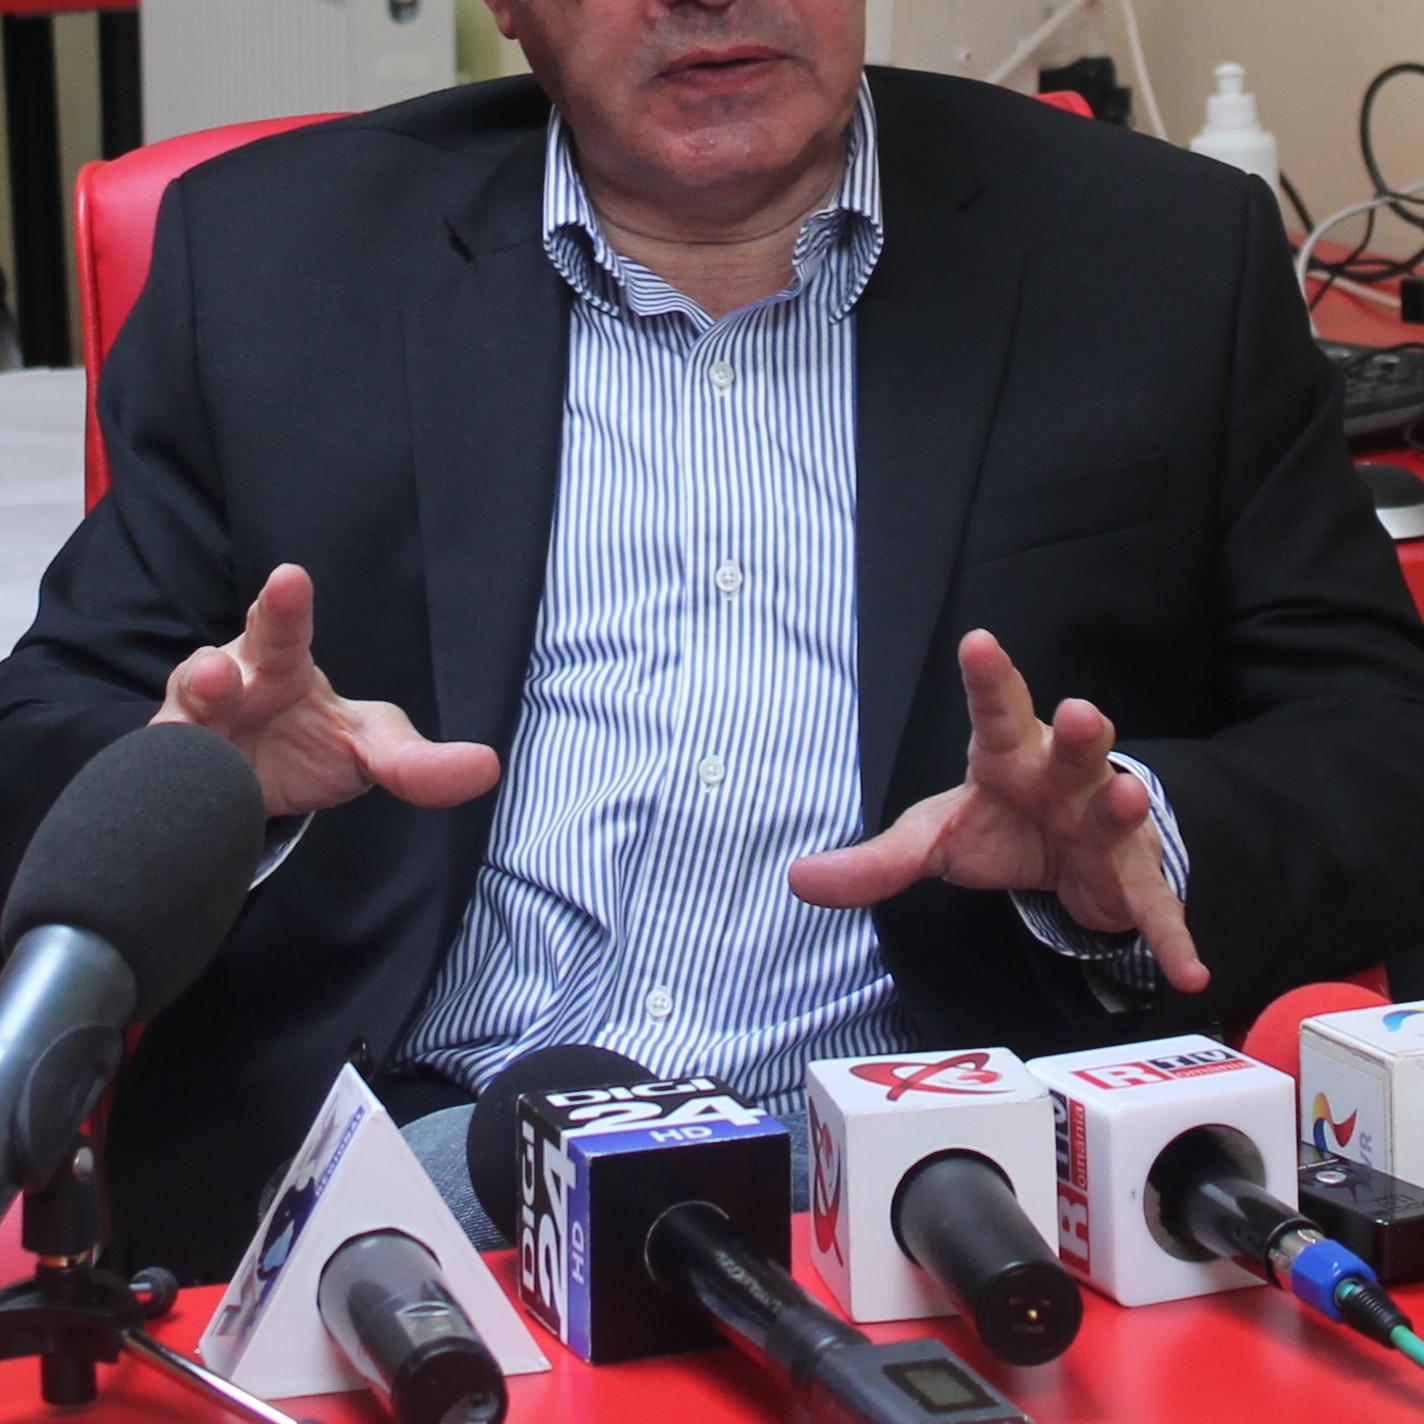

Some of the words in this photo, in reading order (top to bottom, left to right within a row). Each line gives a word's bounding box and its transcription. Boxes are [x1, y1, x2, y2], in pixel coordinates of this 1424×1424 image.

[545, 1077, 716, 1108] DIGI
[566, 1094, 768, 1133] 24
[649, 1125, 714, 1143] HD
[521, 1120, 536, 1293] DIGI
[538, 1137, 577, 1338] 24
[571, 1221, 586, 1285] HD
